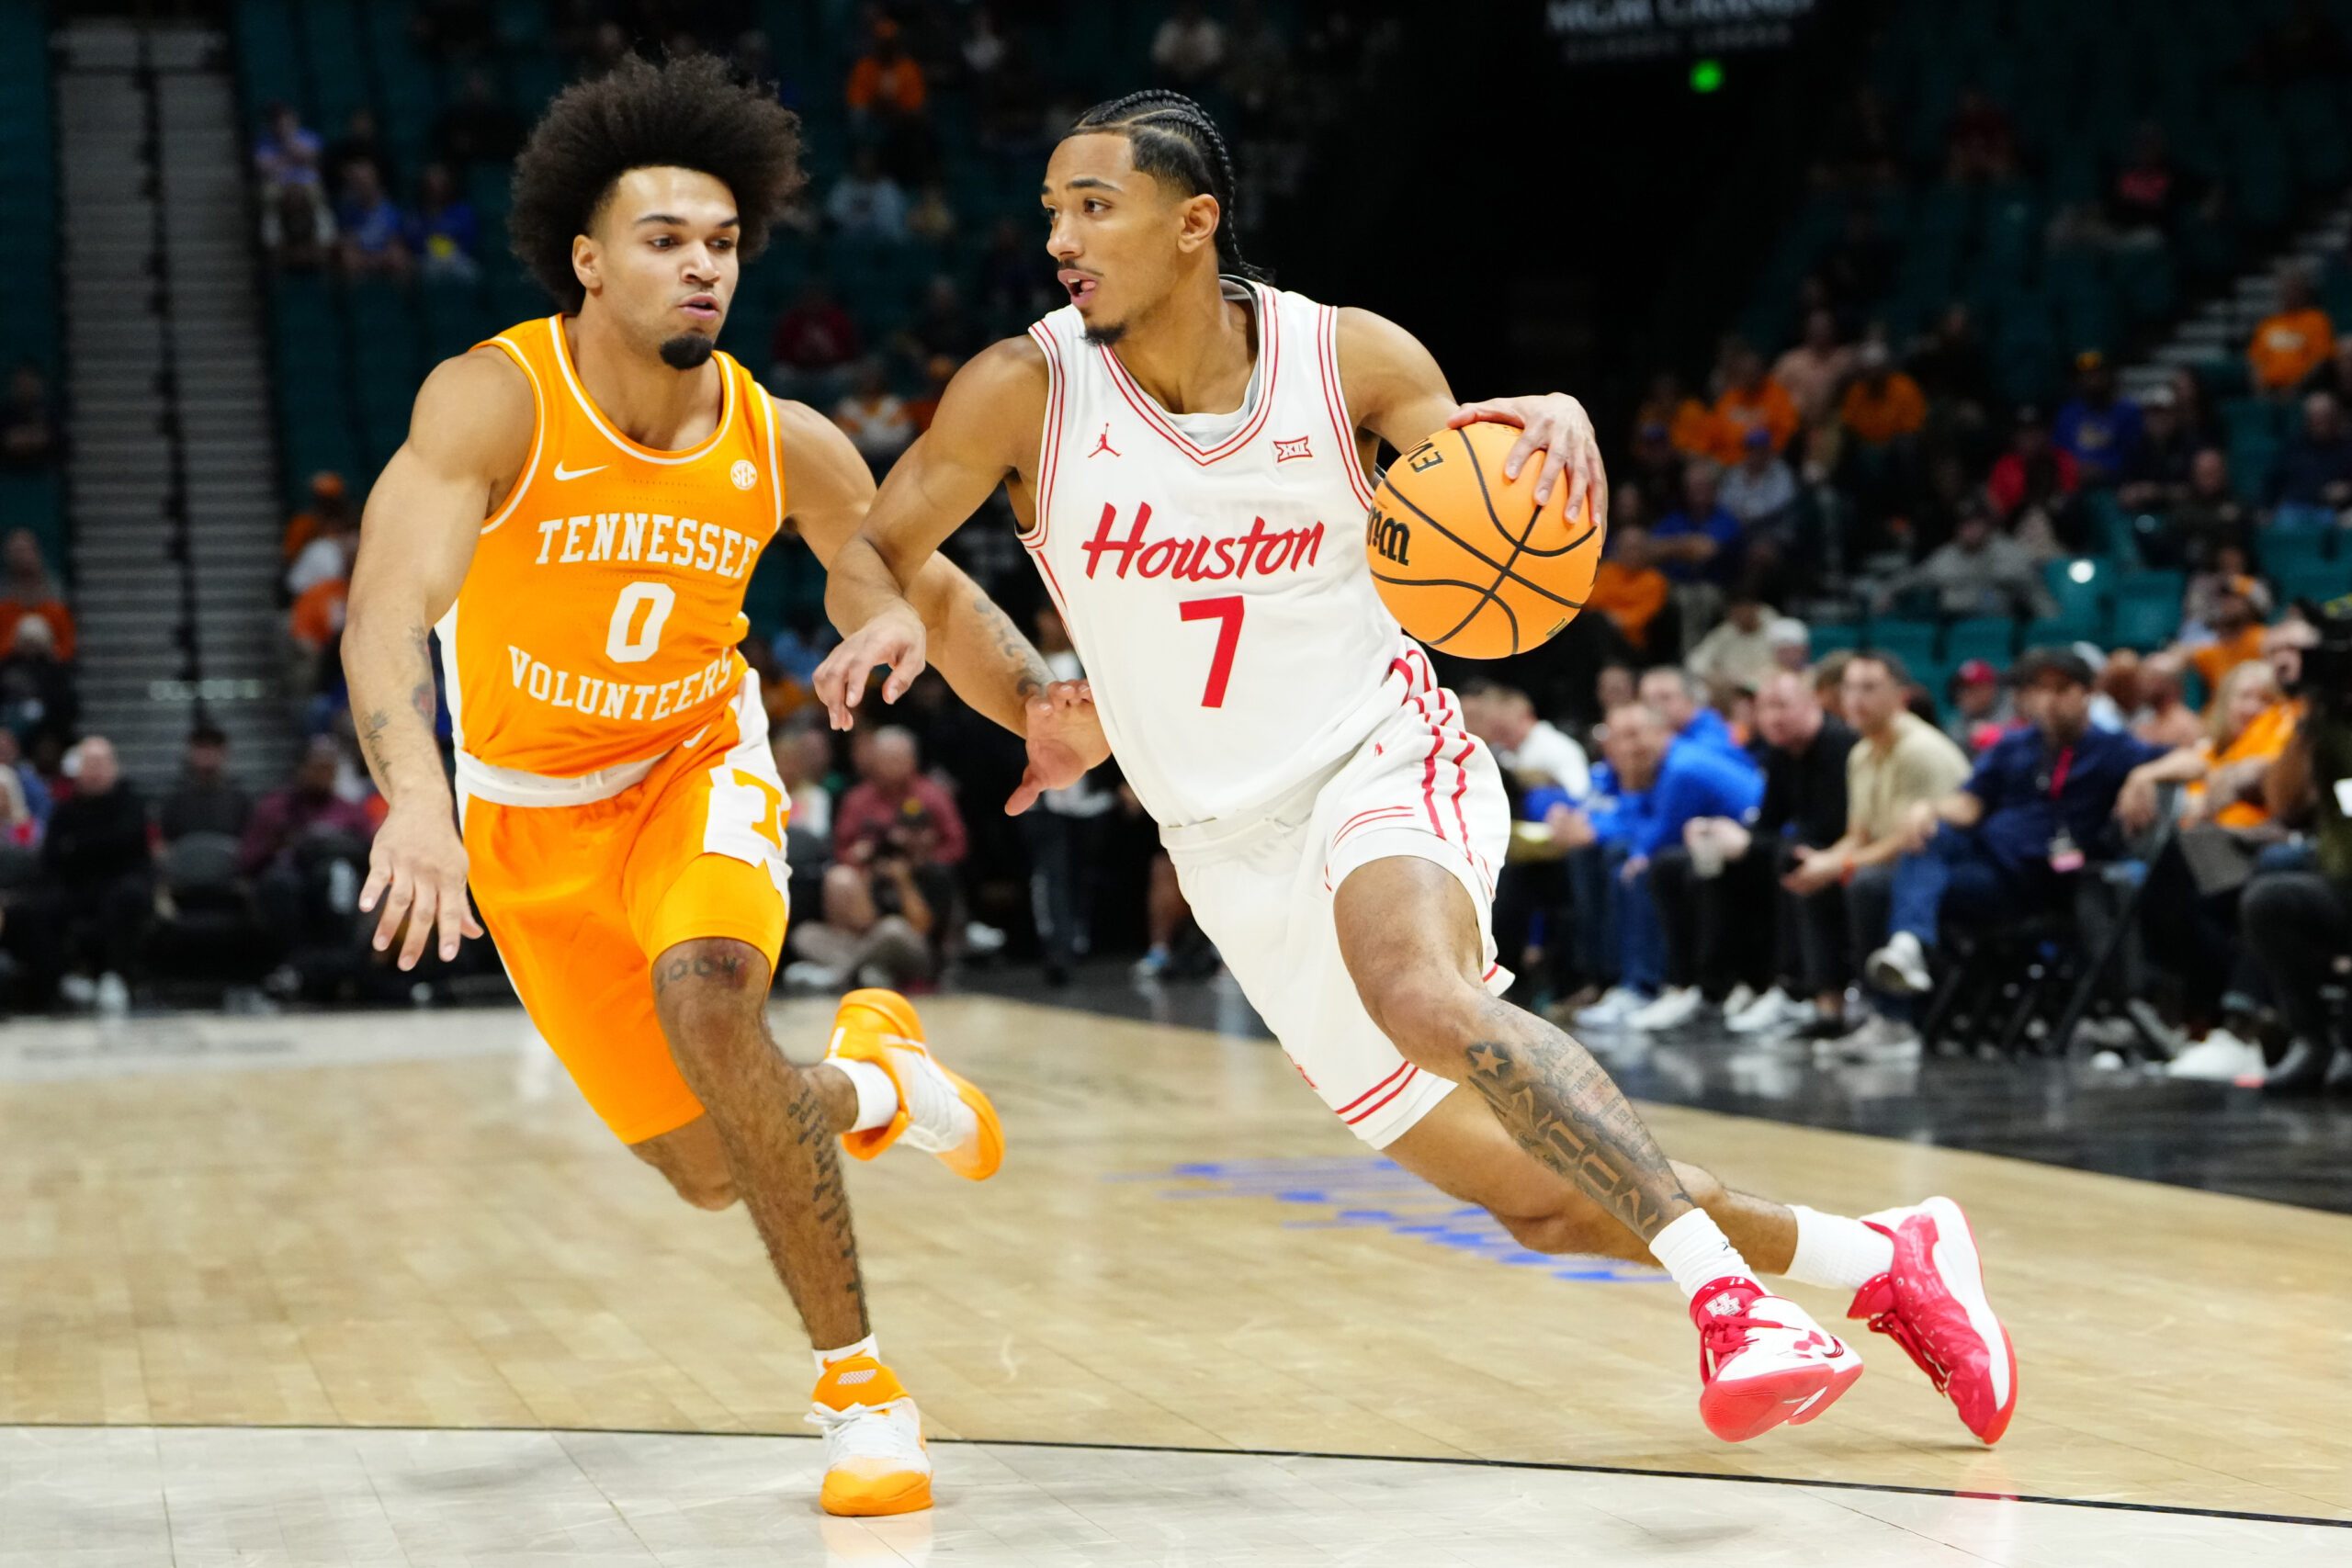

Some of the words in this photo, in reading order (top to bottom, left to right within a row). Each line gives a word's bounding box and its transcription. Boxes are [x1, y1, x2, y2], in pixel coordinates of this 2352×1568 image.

[535, 513, 760, 579] TENNESSEE
[1080, 502, 1325, 582] Houston
[605, 581, 676, 663] 0
[1179, 595, 1245, 708] 7
[507, 646, 733, 722] VOLUNTEERS
